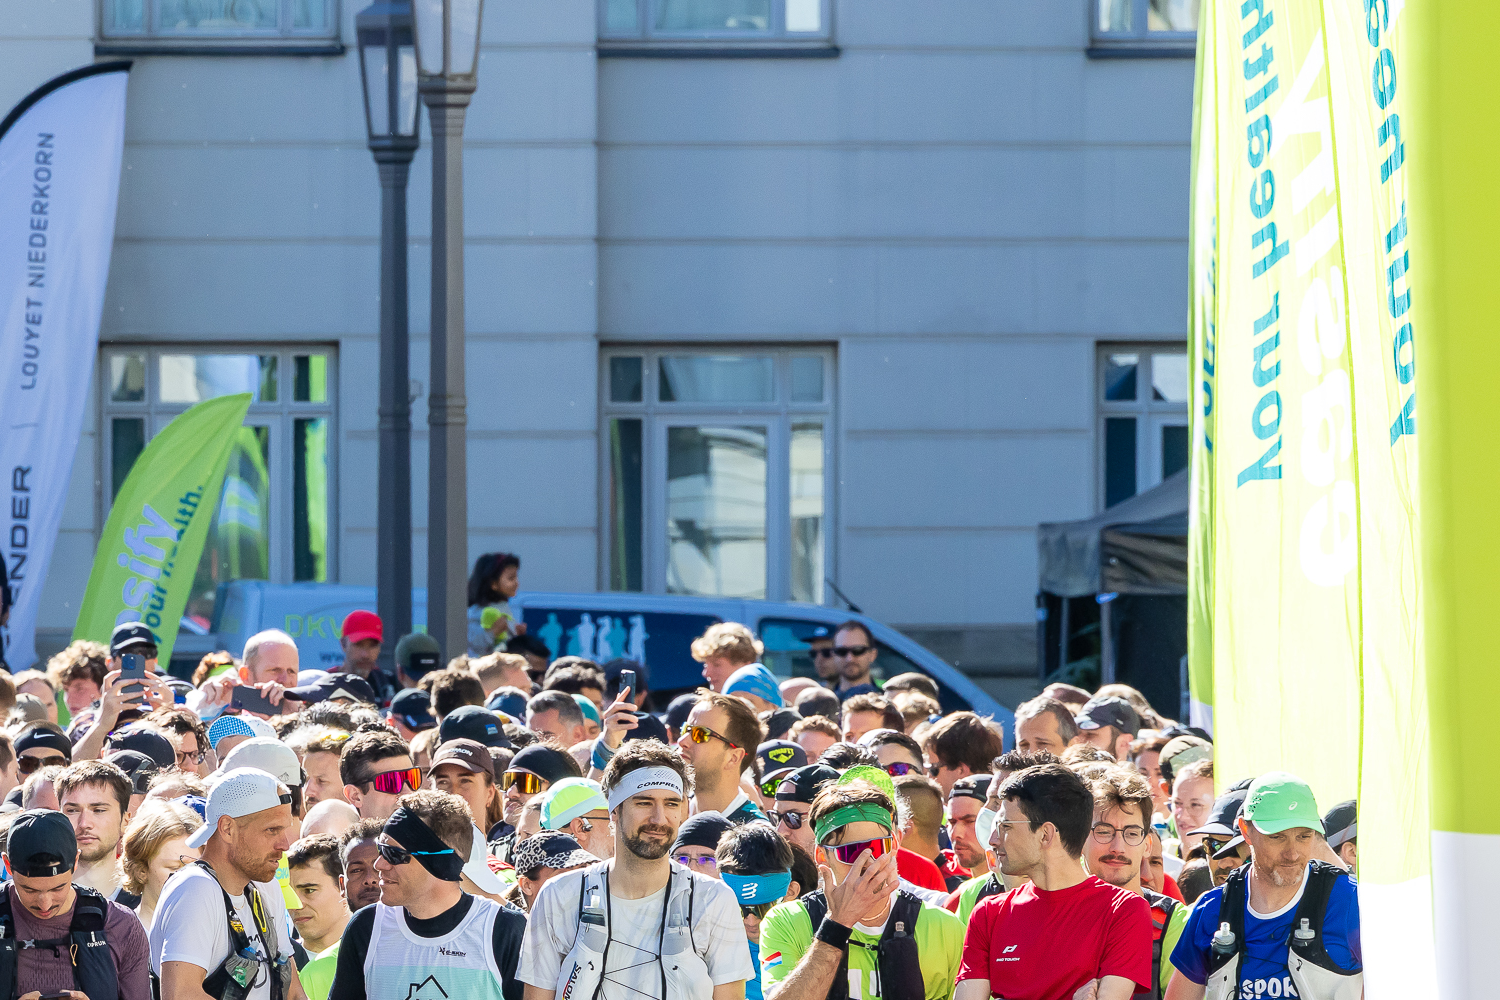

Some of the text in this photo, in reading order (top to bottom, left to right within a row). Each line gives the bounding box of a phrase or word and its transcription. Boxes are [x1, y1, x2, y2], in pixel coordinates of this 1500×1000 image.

[20, 131, 56, 391] LOUYET NIEDERKORN
[636, 780, 682, 794] COMPRES
